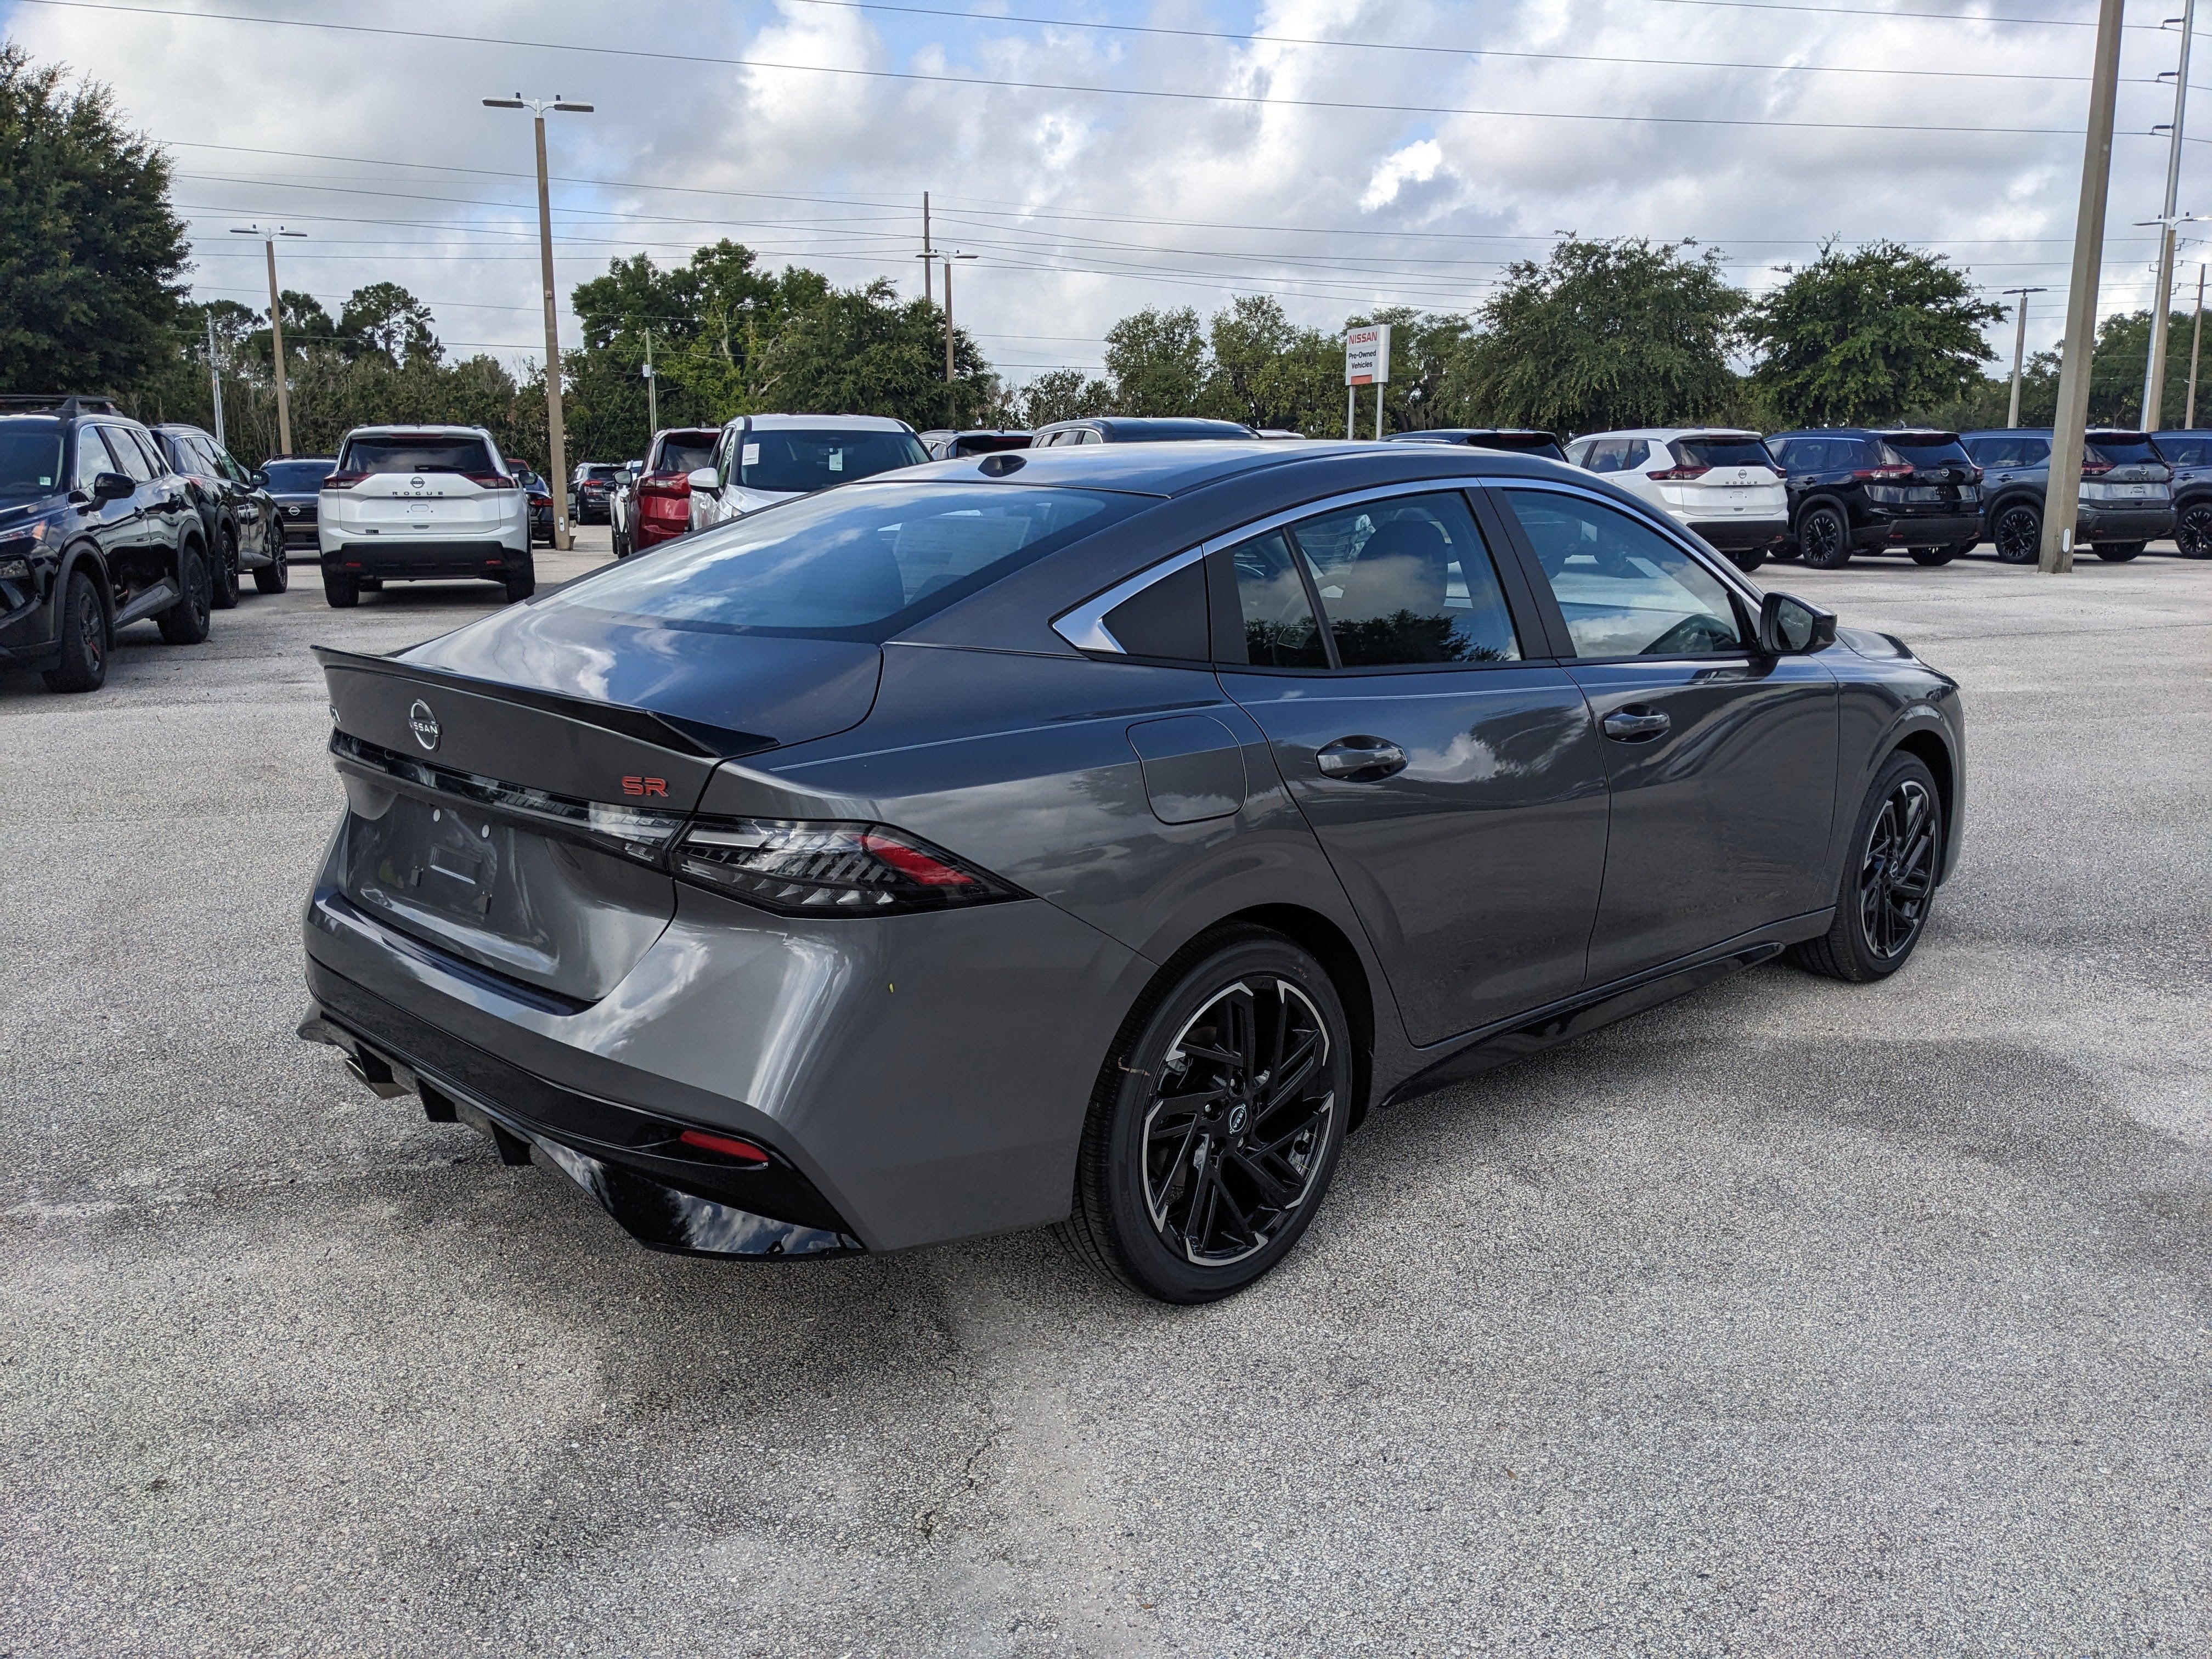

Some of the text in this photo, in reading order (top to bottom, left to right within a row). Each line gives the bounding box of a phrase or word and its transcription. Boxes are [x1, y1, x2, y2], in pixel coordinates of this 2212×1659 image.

[1349, 331, 1378, 345] NISSAN
[1348, 349, 1376, 359] Pre-Owned
[1351, 361, 1373, 369] Vehicles
[622, 776, 669, 797] SR
[1229, 1103, 1246, 1135] NISSAN
